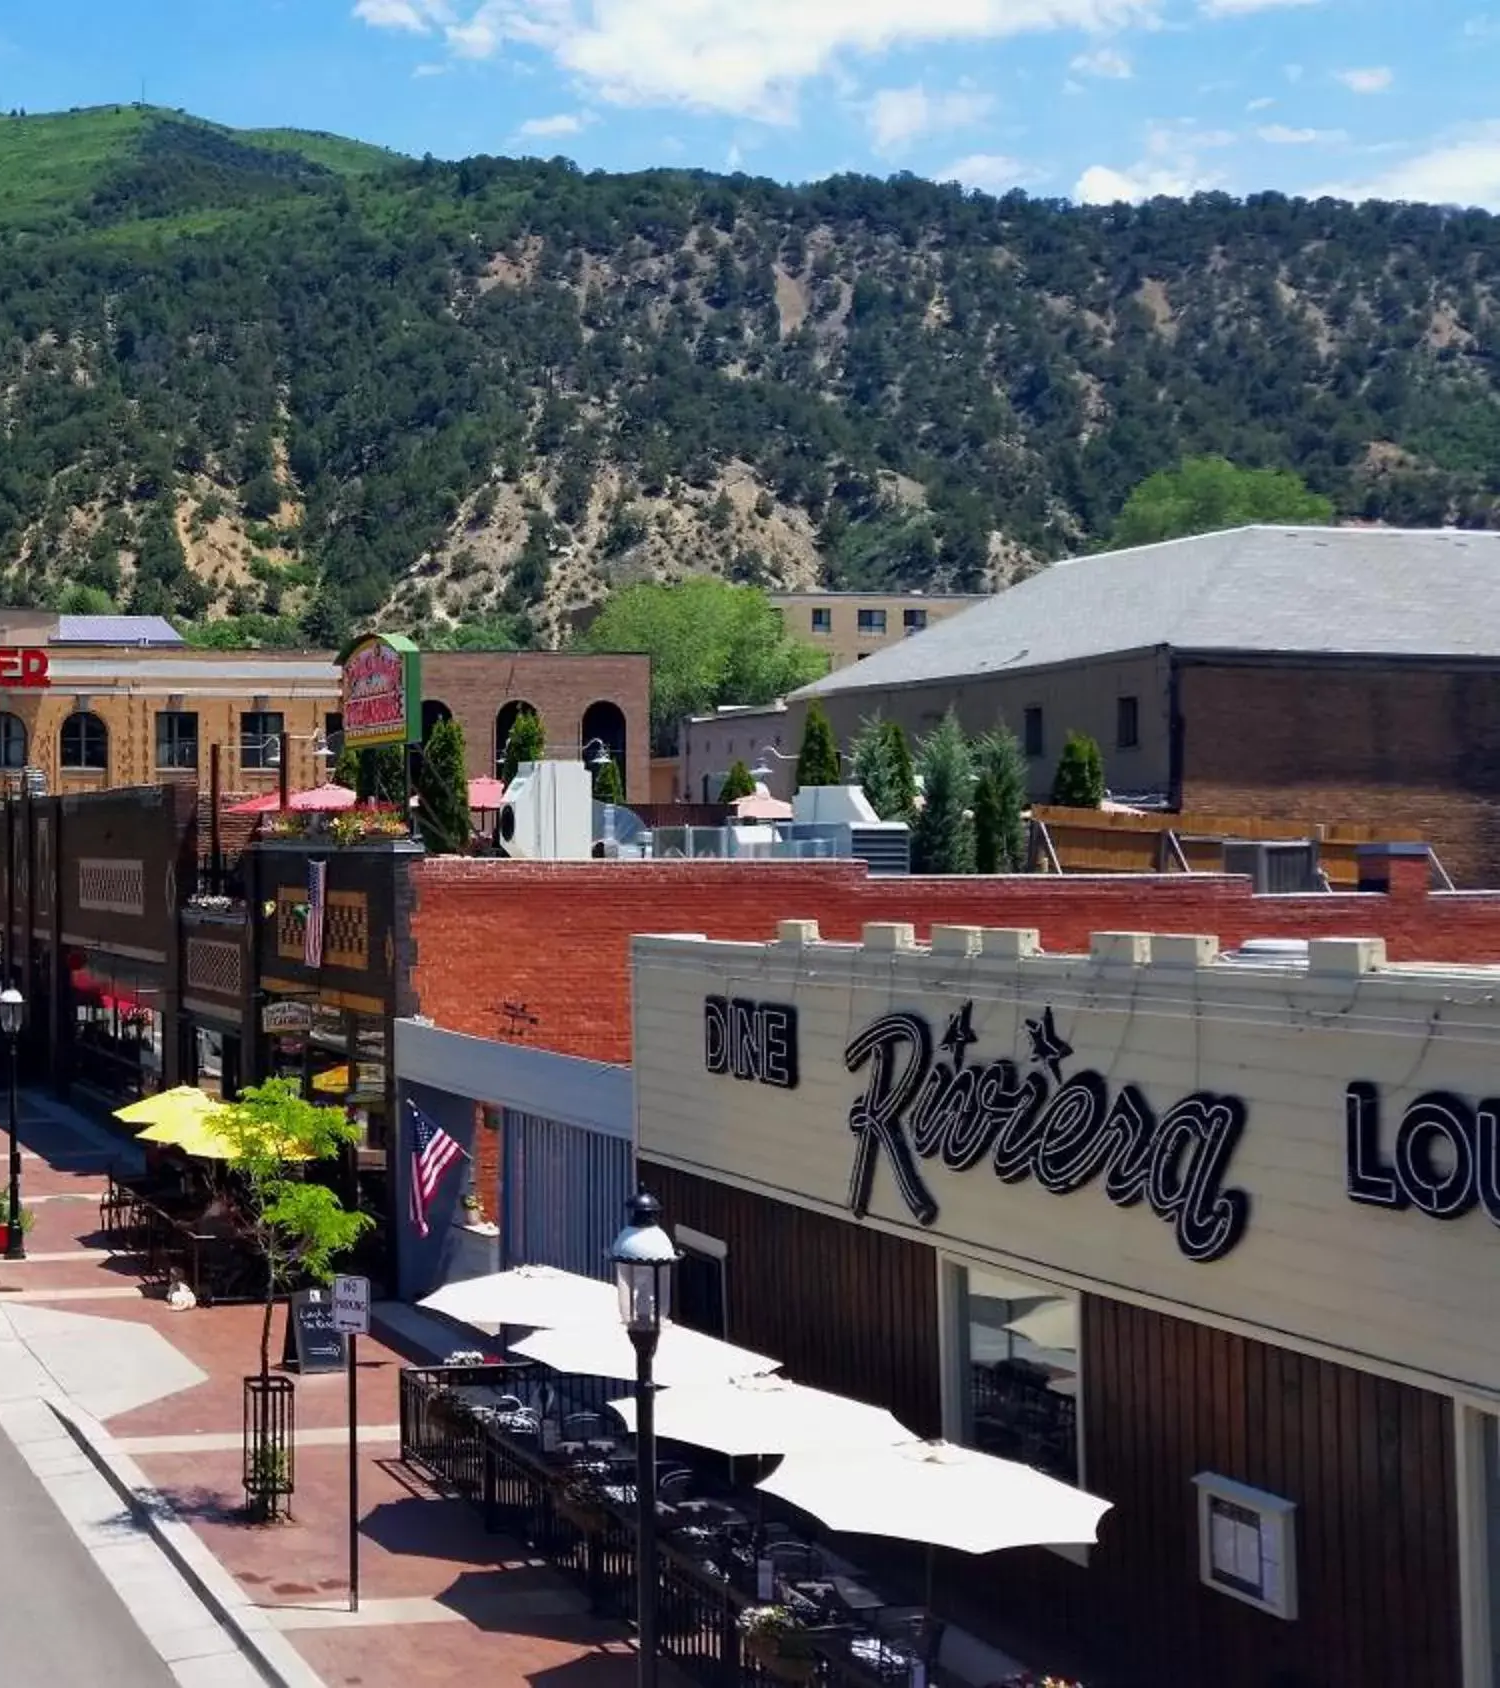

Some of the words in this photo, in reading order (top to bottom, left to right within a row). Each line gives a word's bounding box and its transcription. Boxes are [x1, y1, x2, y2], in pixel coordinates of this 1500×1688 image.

[705, 994, 799, 1089] DINE
[845, 1000, 1250, 1263] Riviera
[335, 1298, 367, 1313] PARKING
[343, 1280, 358, 1294] NO
